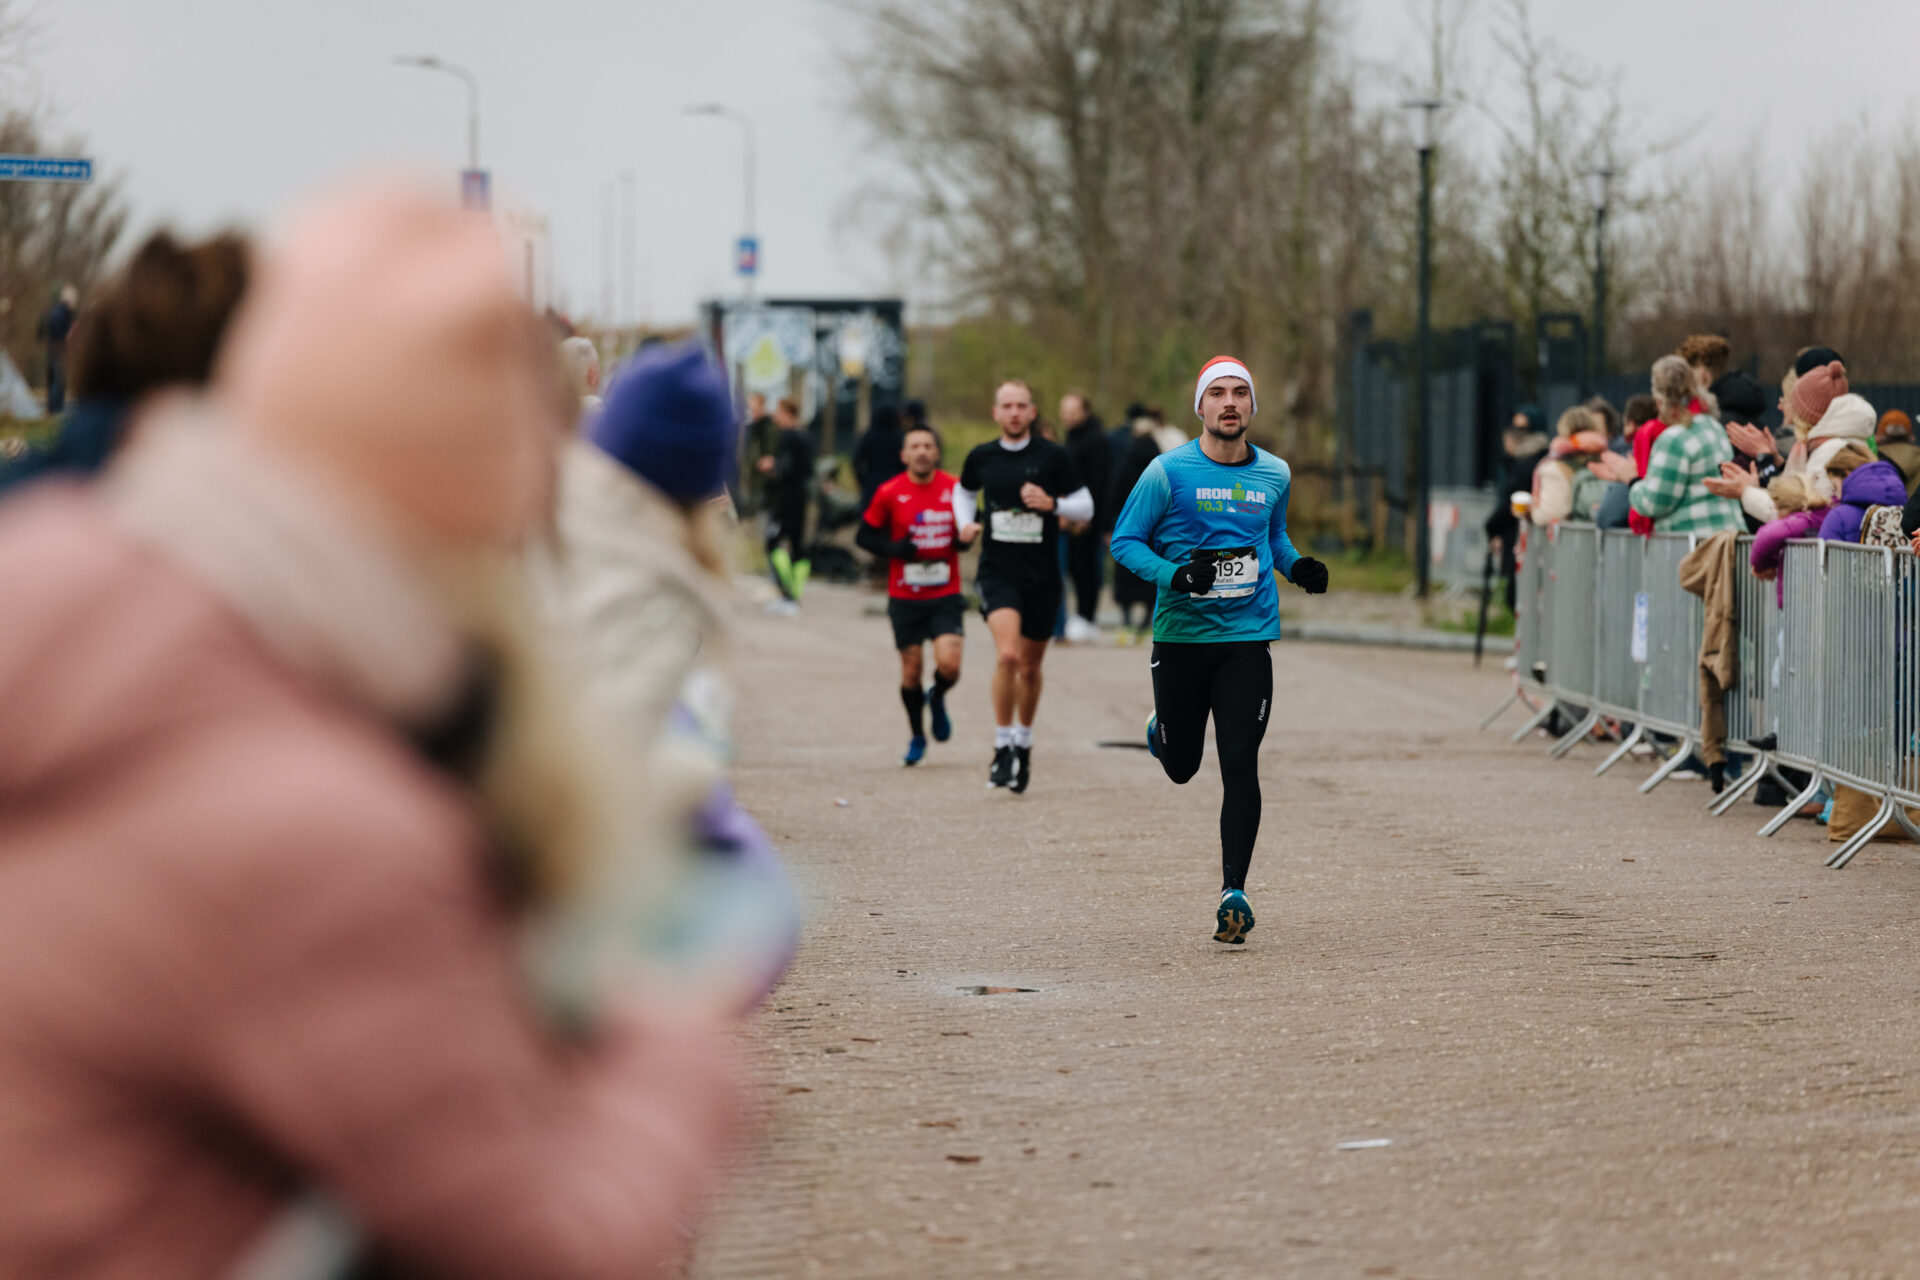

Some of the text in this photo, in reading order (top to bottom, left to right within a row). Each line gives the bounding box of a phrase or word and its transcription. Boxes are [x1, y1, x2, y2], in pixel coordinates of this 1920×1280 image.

[1196, 483, 1266, 504] IRONMAN
[1196, 500, 1223, 512] 70.3
[1258, 698, 1267, 721] FUSION
